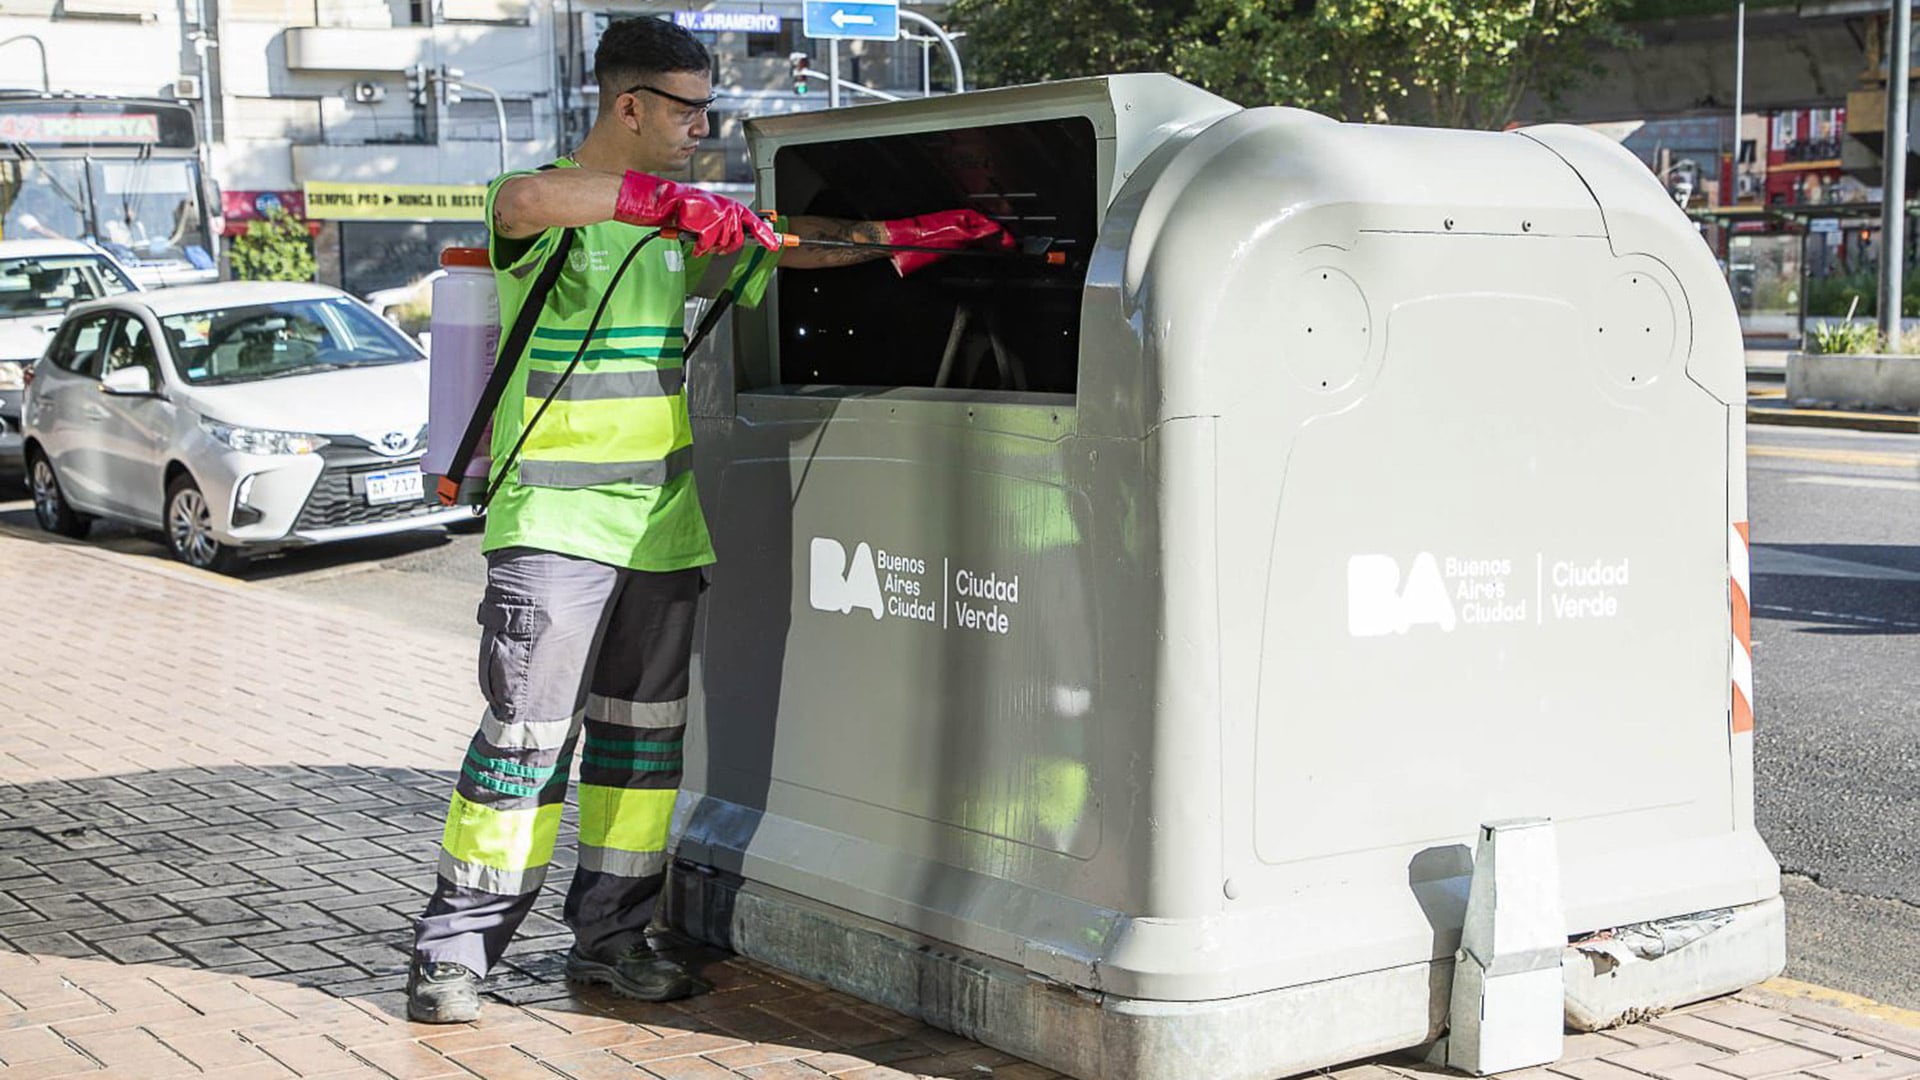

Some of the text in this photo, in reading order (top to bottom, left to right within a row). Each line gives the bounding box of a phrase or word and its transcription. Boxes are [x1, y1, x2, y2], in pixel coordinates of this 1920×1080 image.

[678, 12, 777, 30] AV. JURAMENTO
[308, 193, 484, 207] SIEMPRE PRO NUNCA EL RESTO
[392, 477, 417, 493] 717
[877, 550, 925, 574] Buenos
[1445, 557, 1511, 576] Buenos
[1552, 558, 1629, 587] Ciudad
[810, 537, 884, 620] BA
[884, 574, 920, 596] Aires
[955, 569, 1018, 603] Ciudad
[1456, 578, 1505, 600] Aires
[1348, 552, 1456, 636] BA
[1552, 591, 1617, 619] Verde
[888, 597, 935, 622] Ciudad
[955, 601, 1009, 634] Verde
[1462, 600, 1526, 624] Ciudad
